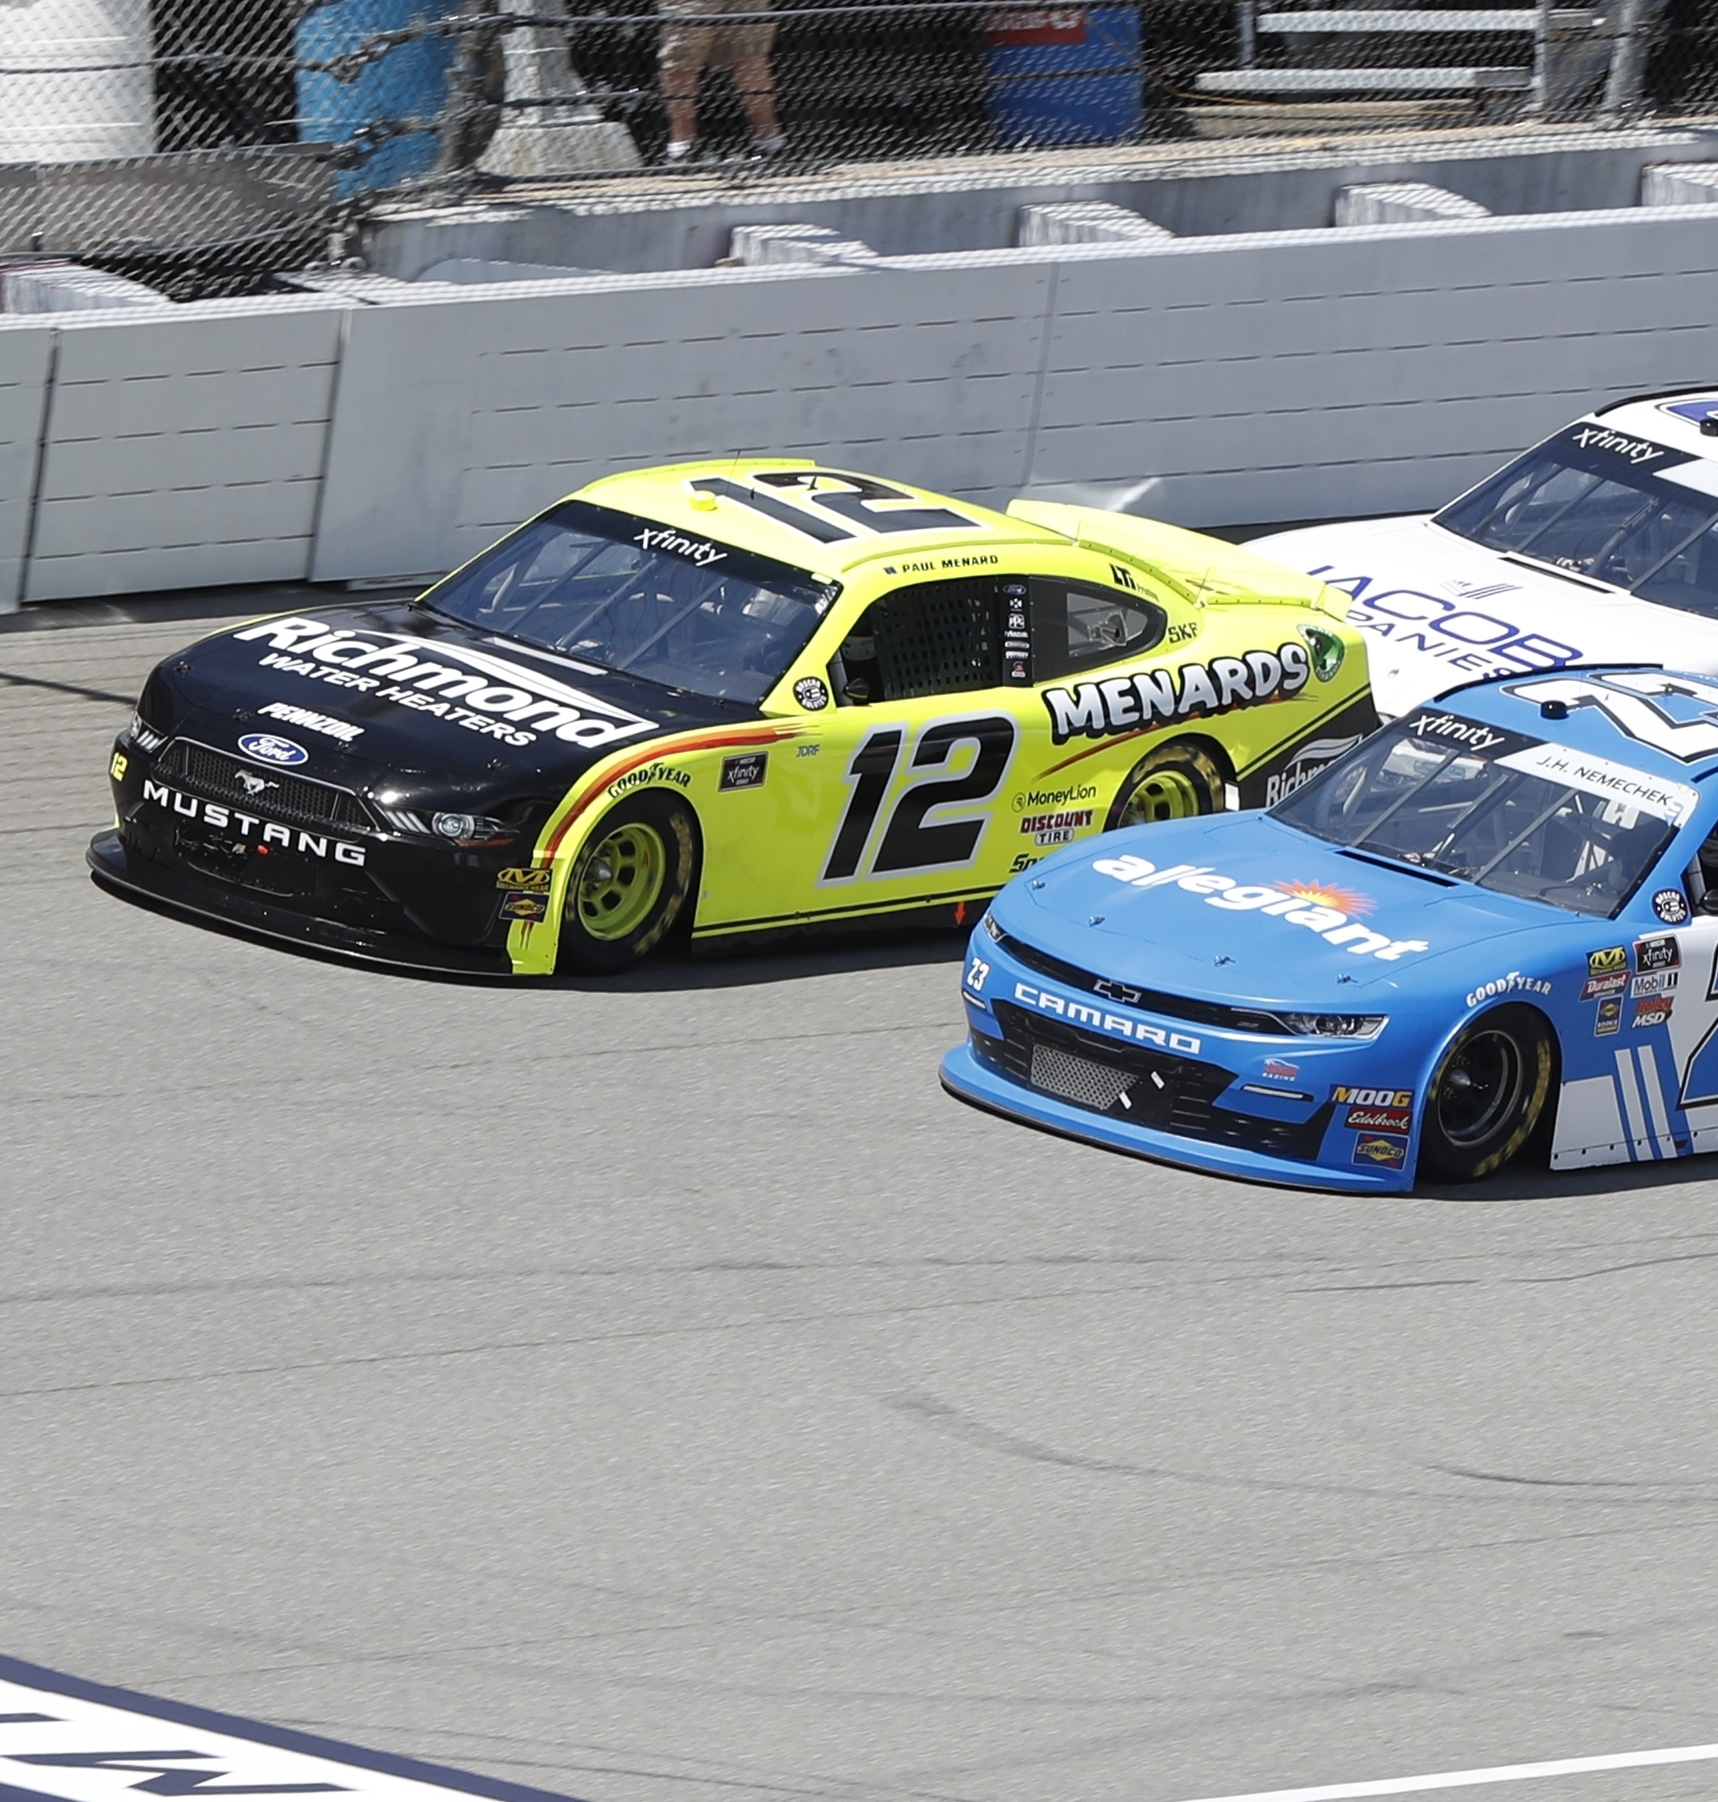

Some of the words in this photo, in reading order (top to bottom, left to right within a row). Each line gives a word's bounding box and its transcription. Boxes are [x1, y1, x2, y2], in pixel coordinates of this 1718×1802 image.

[1572, 426, 1664, 464] xfinity
[687, 471, 984, 544] 12
[633, 526, 728, 567] xfinity
[902, 561, 936, 573] PAUL
[942, 555, 999, 570] MENARD
[1168, 622, 1197, 644] SKF
[1307, 566, 1583, 670] ACOB
[233, 616, 640, 748] Richmond
[258, 652, 380, 693] WATER
[376, 684, 537, 747] HEATERS
[1043, 643, 1311, 742] MENARDS
[258, 702, 365, 743] PENNZOIL
[1409, 714, 1504, 751] xfinity
[110, 752, 128, 782] 12
[243, 735, 302, 764] Ford
[607, 763, 692, 799] GOODYEAR
[727, 766, 759, 783] xfinity
[1536, 756, 1569, 773] J.H.
[1573, 766, 1674, 806] NEMECHEK
[818, 712, 1018, 885] 12
[1028, 784, 1096, 807] MoneyLion
[143, 779, 366, 867] MUSTANG
[1020, 810, 1093, 833] DISCOUNT
[1039, 830, 1071, 844] TIRE
[1092, 854, 1428, 961] allegiant
[966, 957, 990, 991] 23
[1642, 947, 1673, 967] xfinity
[1466, 971, 1551, 1008] GOODYEAR
[1587, 974, 1626, 993] Duralast
[1634, 975, 1666, 994] Mobil
[1014, 982, 1201, 1055] CAMARO
[1632, 1011, 1666, 1028] MSD
[1331, 1087, 1412, 1107] MOOG
[1348, 1111, 1409, 1130] Edelbrock
[1357, 1143, 1404, 1159] SUNOCO
